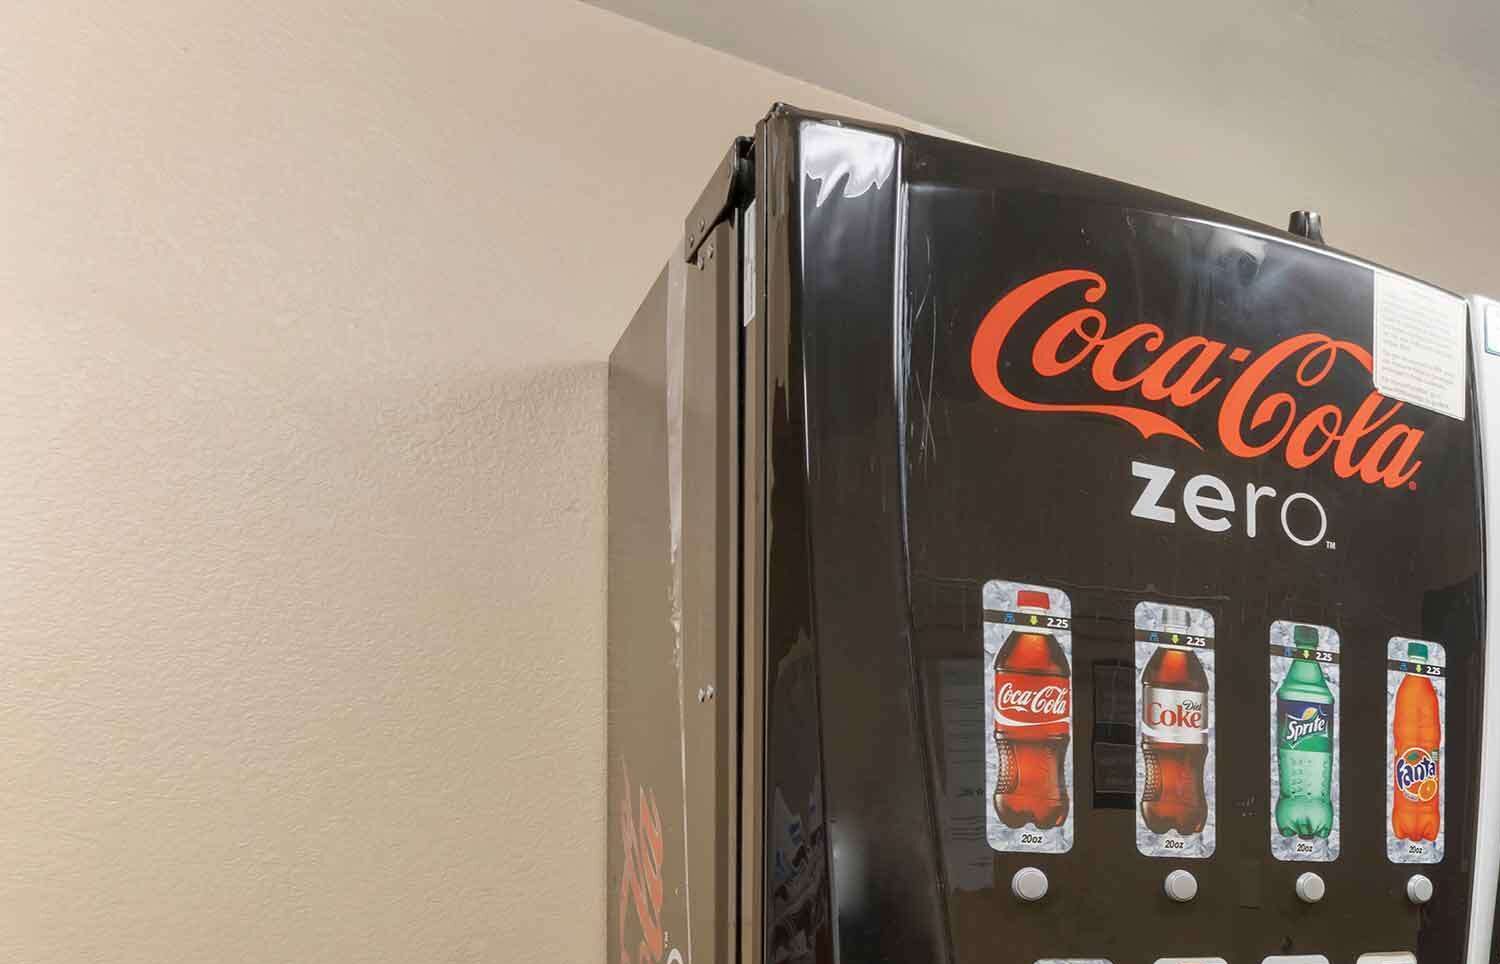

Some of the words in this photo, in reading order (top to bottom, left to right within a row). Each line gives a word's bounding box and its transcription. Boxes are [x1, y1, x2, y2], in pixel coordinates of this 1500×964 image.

[970, 269, 1424, 491] Coca-Cola
[1047, 618, 1069, 629] 2.25
[1186, 635, 1206, 647] 2.25
[1315, 651, 1333, 661] 2.25
[1426, 665, 1440, 676] 2.25
[998, 683, 1068, 714] Coca-Cola
[1146, 702, 1202, 729] Coke
[1286, 716, 1325, 741] Sprite
[1021, 833, 1043, 846] 20oz
[1164, 838, 1184, 850] 20oz
[1296, 842, 1313, 854] 20oz
